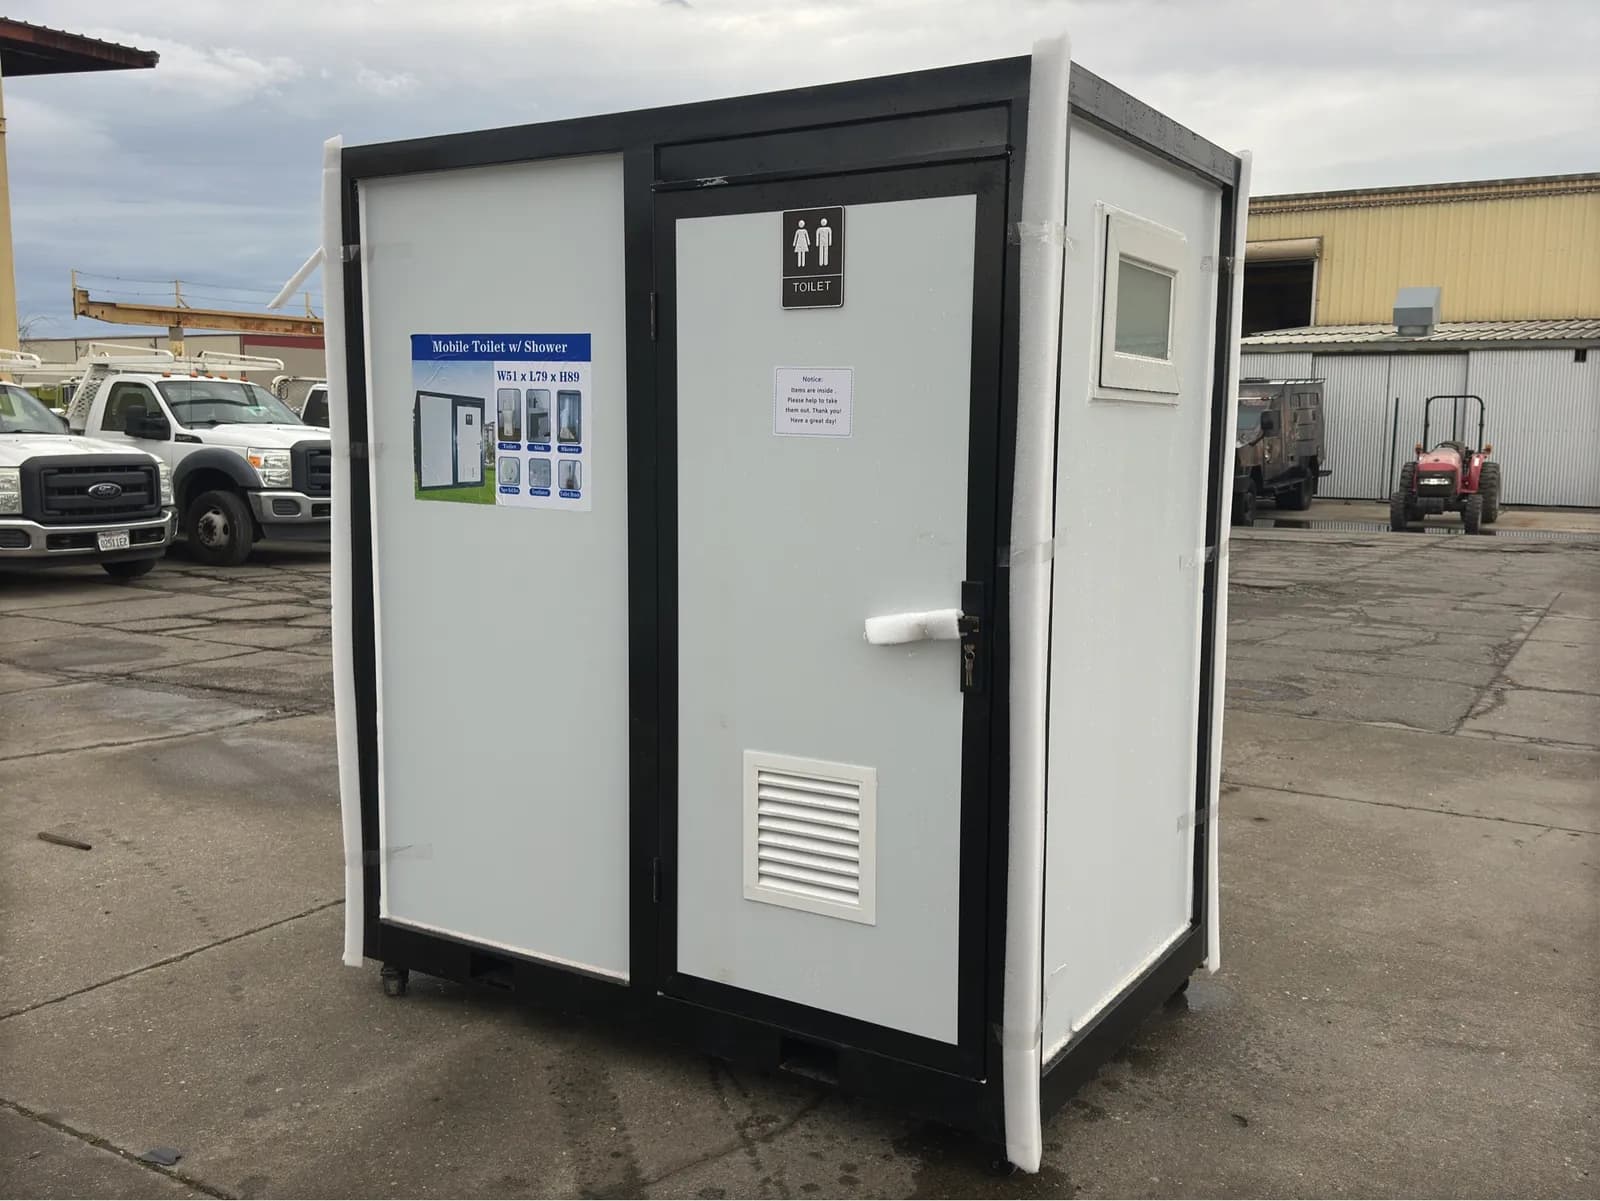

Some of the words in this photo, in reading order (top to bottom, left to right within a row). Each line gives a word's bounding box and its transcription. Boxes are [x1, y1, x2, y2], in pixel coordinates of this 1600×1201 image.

[792, 280, 831, 292] TOILET
[432, 341, 469, 353] Mobile
[472, 341, 505, 353] Toilet
[509, 341, 522, 353] w/
[524, 341, 568, 353] Shower
[497, 371, 517, 382] W51
[520, 373, 527, 382] x
[529, 371, 548, 382] L79
[551, 374, 556, 382] x
[559, 372, 580, 382] H89
